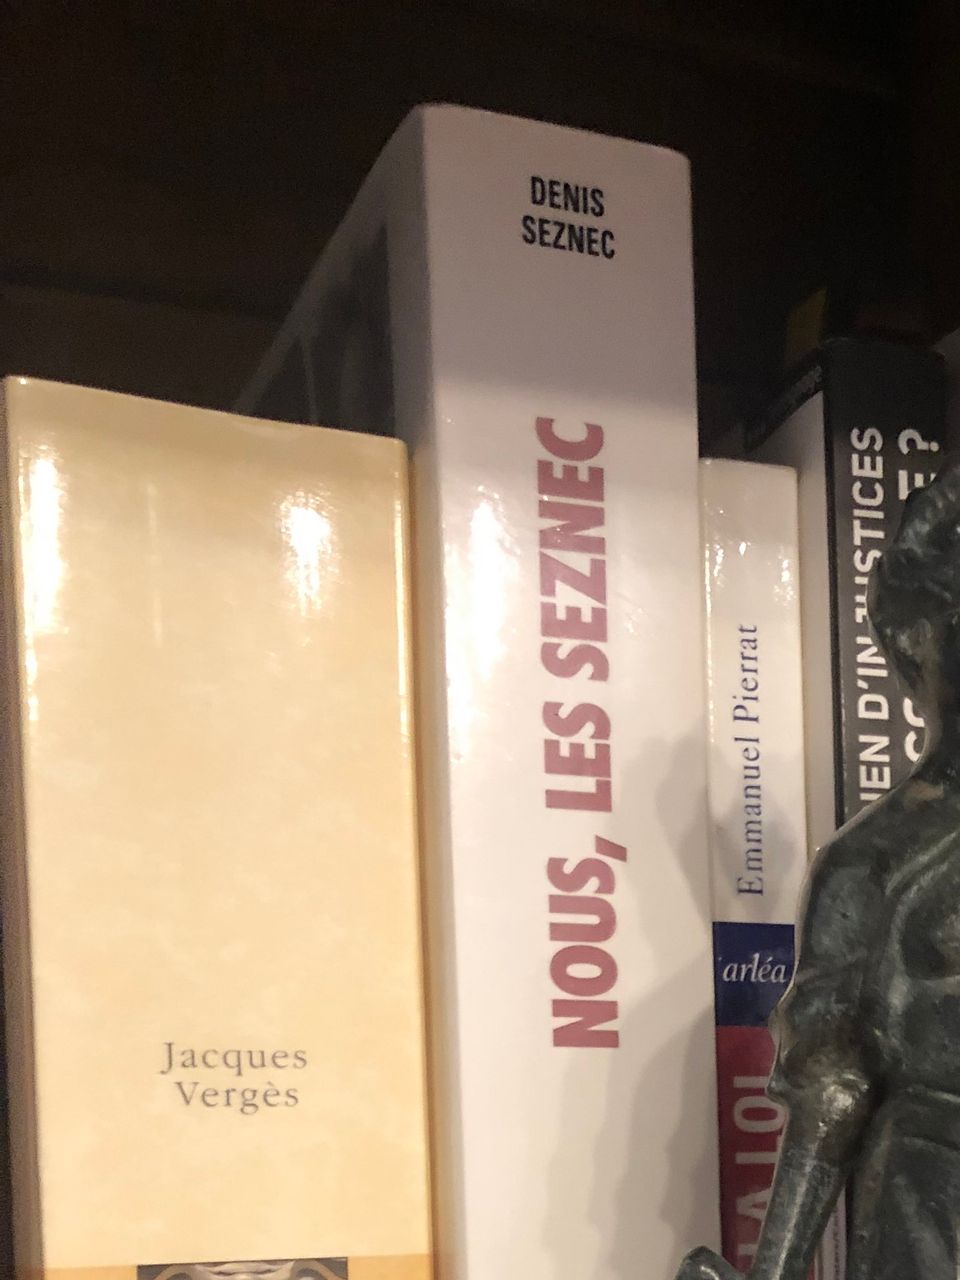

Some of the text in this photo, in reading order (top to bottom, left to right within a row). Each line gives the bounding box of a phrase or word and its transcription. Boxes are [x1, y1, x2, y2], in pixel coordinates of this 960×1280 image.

[531, 176, 605, 217] DENIS
[522, 215, 616, 259] SEZNEC
[535, 416, 628, 1048] NOUS, LES SEZNEC
[732, 624, 764, 898] Emmanuel Pierrat
[722, 953, 787, 984] arléa
[160, 1042, 308, 1076] Jacques
[174, 1081, 299, 1115] Vergès
